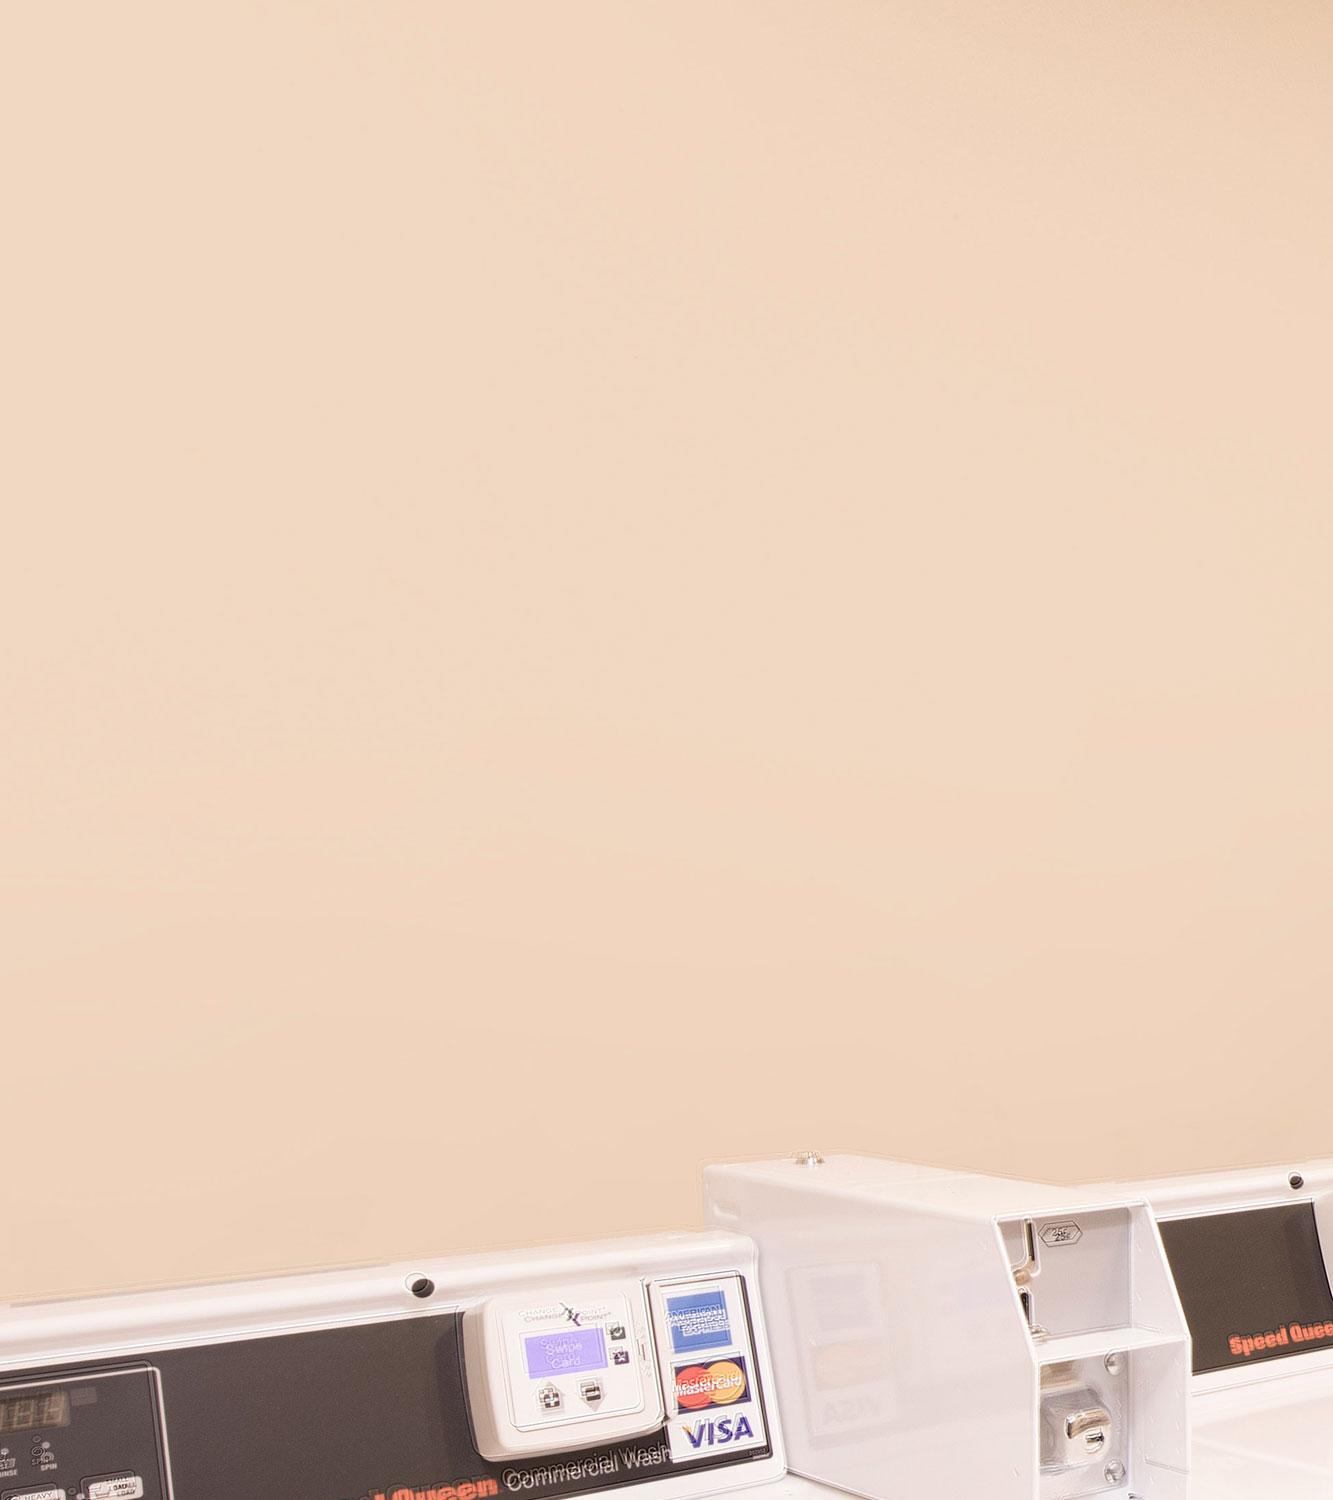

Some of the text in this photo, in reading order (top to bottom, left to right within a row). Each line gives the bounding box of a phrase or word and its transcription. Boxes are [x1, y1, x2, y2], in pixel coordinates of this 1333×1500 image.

[1229, 1325, 1288, 1356] Speed
[682, 1416, 753, 1448] VISA
[506, 1453, 618, 1492] Commercial
